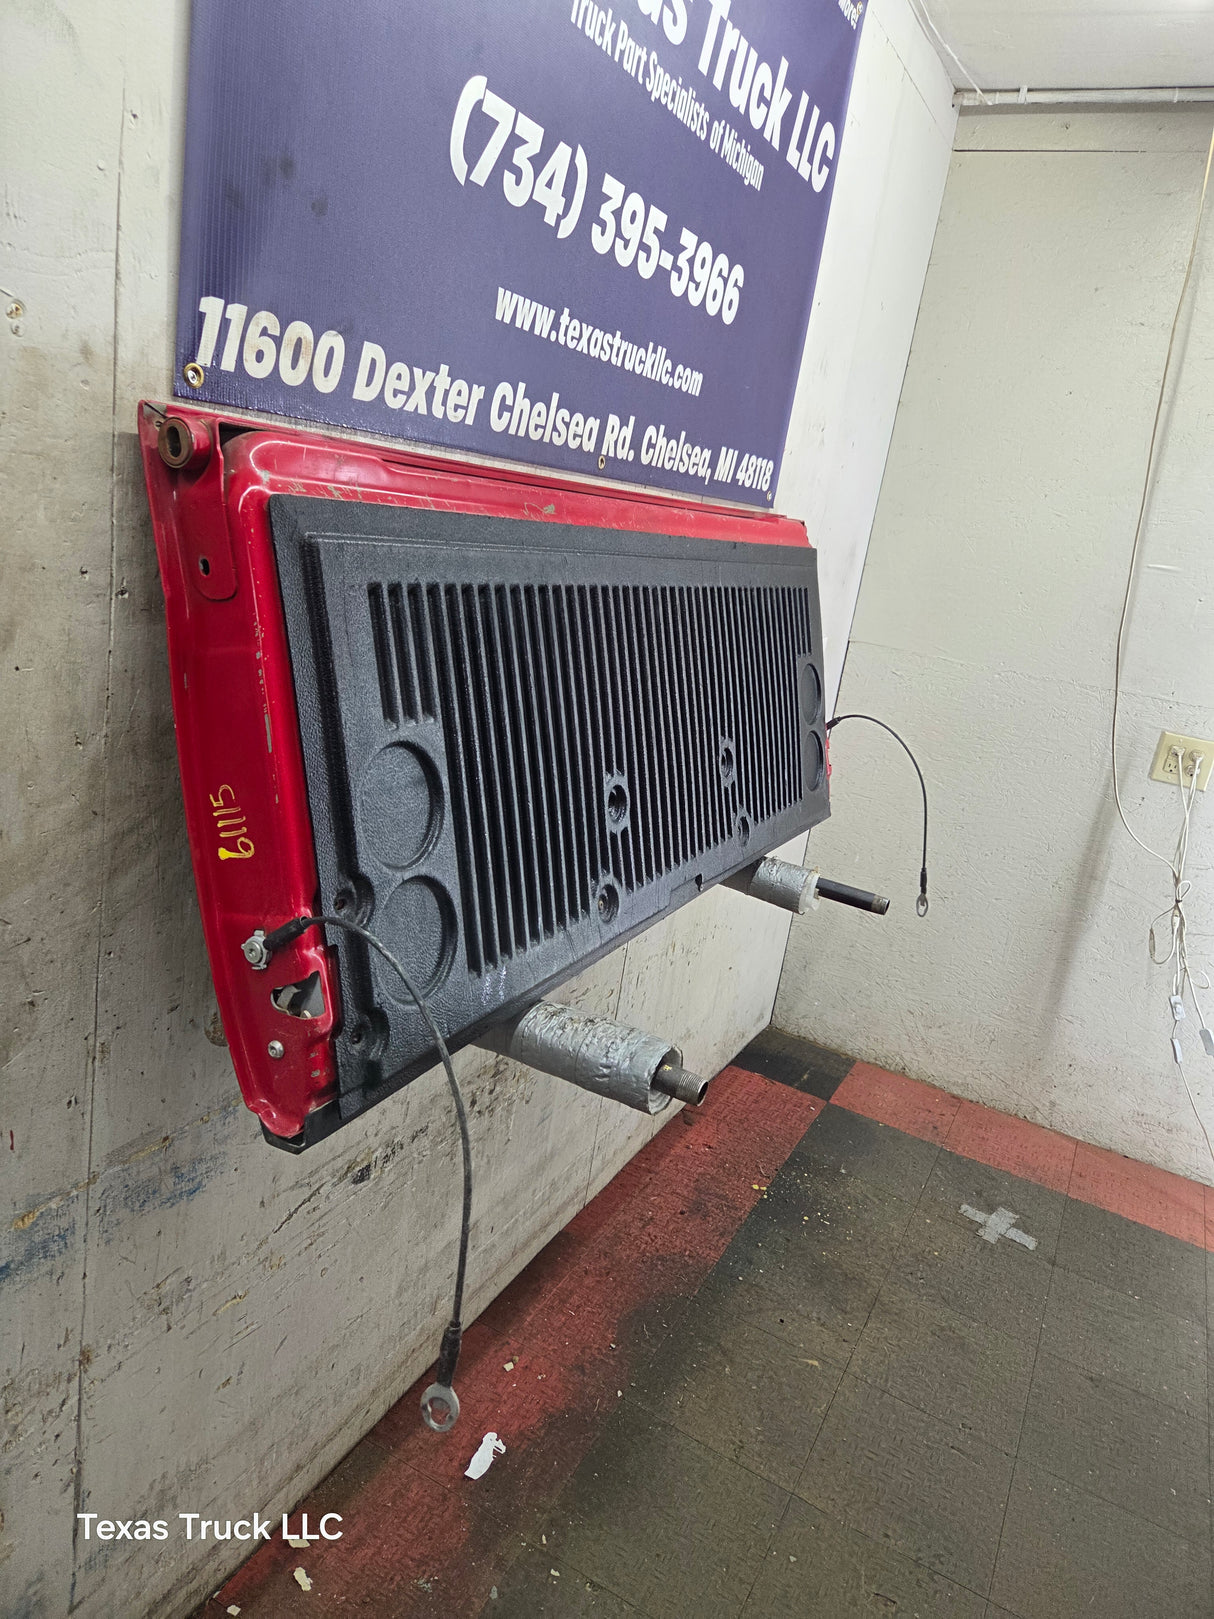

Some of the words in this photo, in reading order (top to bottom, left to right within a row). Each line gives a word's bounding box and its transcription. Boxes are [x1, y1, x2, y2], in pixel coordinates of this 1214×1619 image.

[570, 0, 616, 57] Truck
[614, 19, 647, 84] Part
[645, 50, 709, 141] Specialists
[709, 119, 726, 154] of
[720, 123, 765, 192] Michigan
[689, 0, 792, 151] Truck
[786, 90, 835, 193] LLC
[449, 75, 588, 239] (734)
[591, 172, 745, 325] 395-3966
[195, 296, 346, 394] 11600
[352, 341, 485, 426] Dexter
[489, 381, 600, 453] Chelsea
[600, 413, 636, 462] Rd.
[640, 424, 712, 485] Chelsea,
[713, 446, 739, 483] MI
[735, 453, 774, 492] 48118
[495, 286, 704, 396] www.texastruckllc.com
